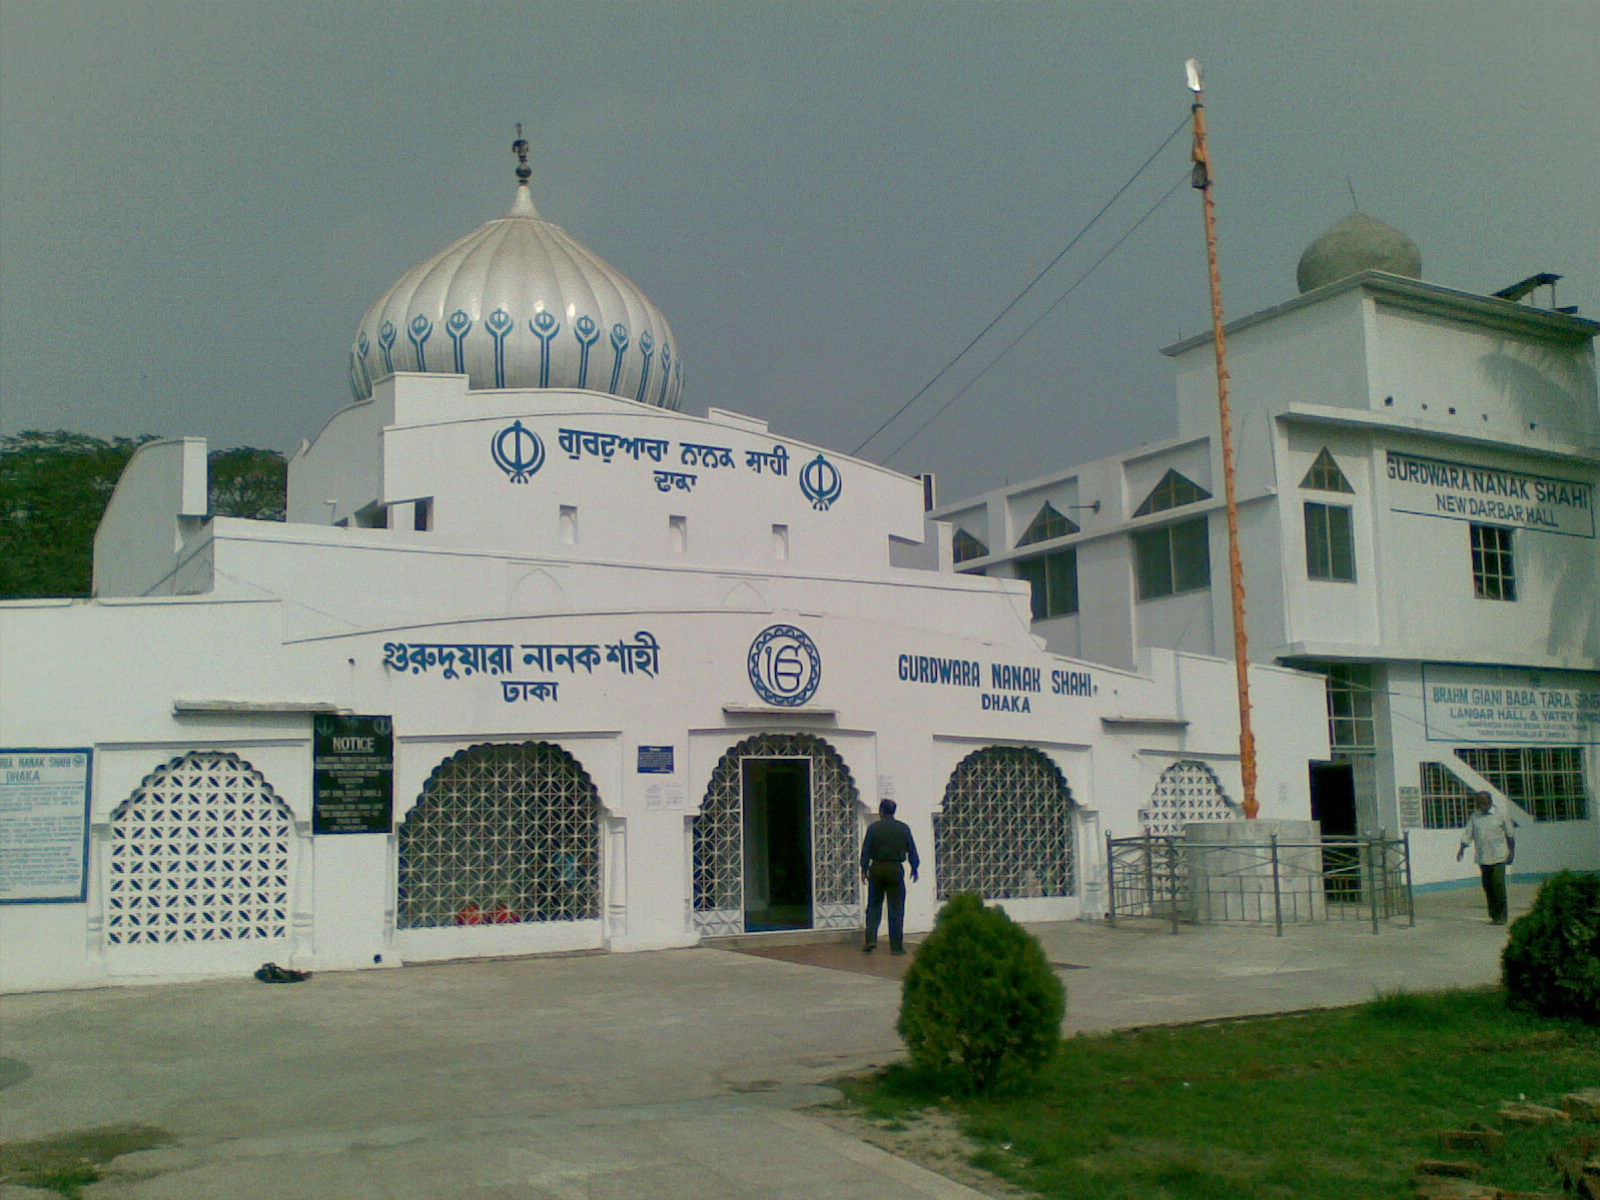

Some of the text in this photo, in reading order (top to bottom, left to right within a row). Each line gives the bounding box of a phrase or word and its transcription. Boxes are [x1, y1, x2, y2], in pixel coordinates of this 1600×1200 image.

[558, 428, 669, 463] ਗੁਰਦੁਆਰਾ
[680, 442, 735, 469] ਨਾਨਕ
[1387, 457, 1587, 509] GURDWARA NANAK SHAHI
[1435, 493, 1559, 527] NEW DARBAR HALL
[383, 631, 661, 680] গুরুদুয়ারা নানক শাহী
[898, 654, 1092, 697] GURDWARA NANAK SHAHI
[501, 681, 559, 702] ঢাকা
[1433, 687, 1469, 704] BRAHM
[1472, 688, 1502, 706] GIANI
[1505, 690, 1537, 707] BABA
[1539, 692, 1572, 708] TARA
[981, 693, 1031, 714] DHAKA
[1450, 708, 1494, 719] LANGAR
[1498, 709, 1526, 721] HALL
[1530, 711, 1539, 721] &
[333, 737, 375, 751] NOTICE
[7, 771, 40, 782] DHAKA
